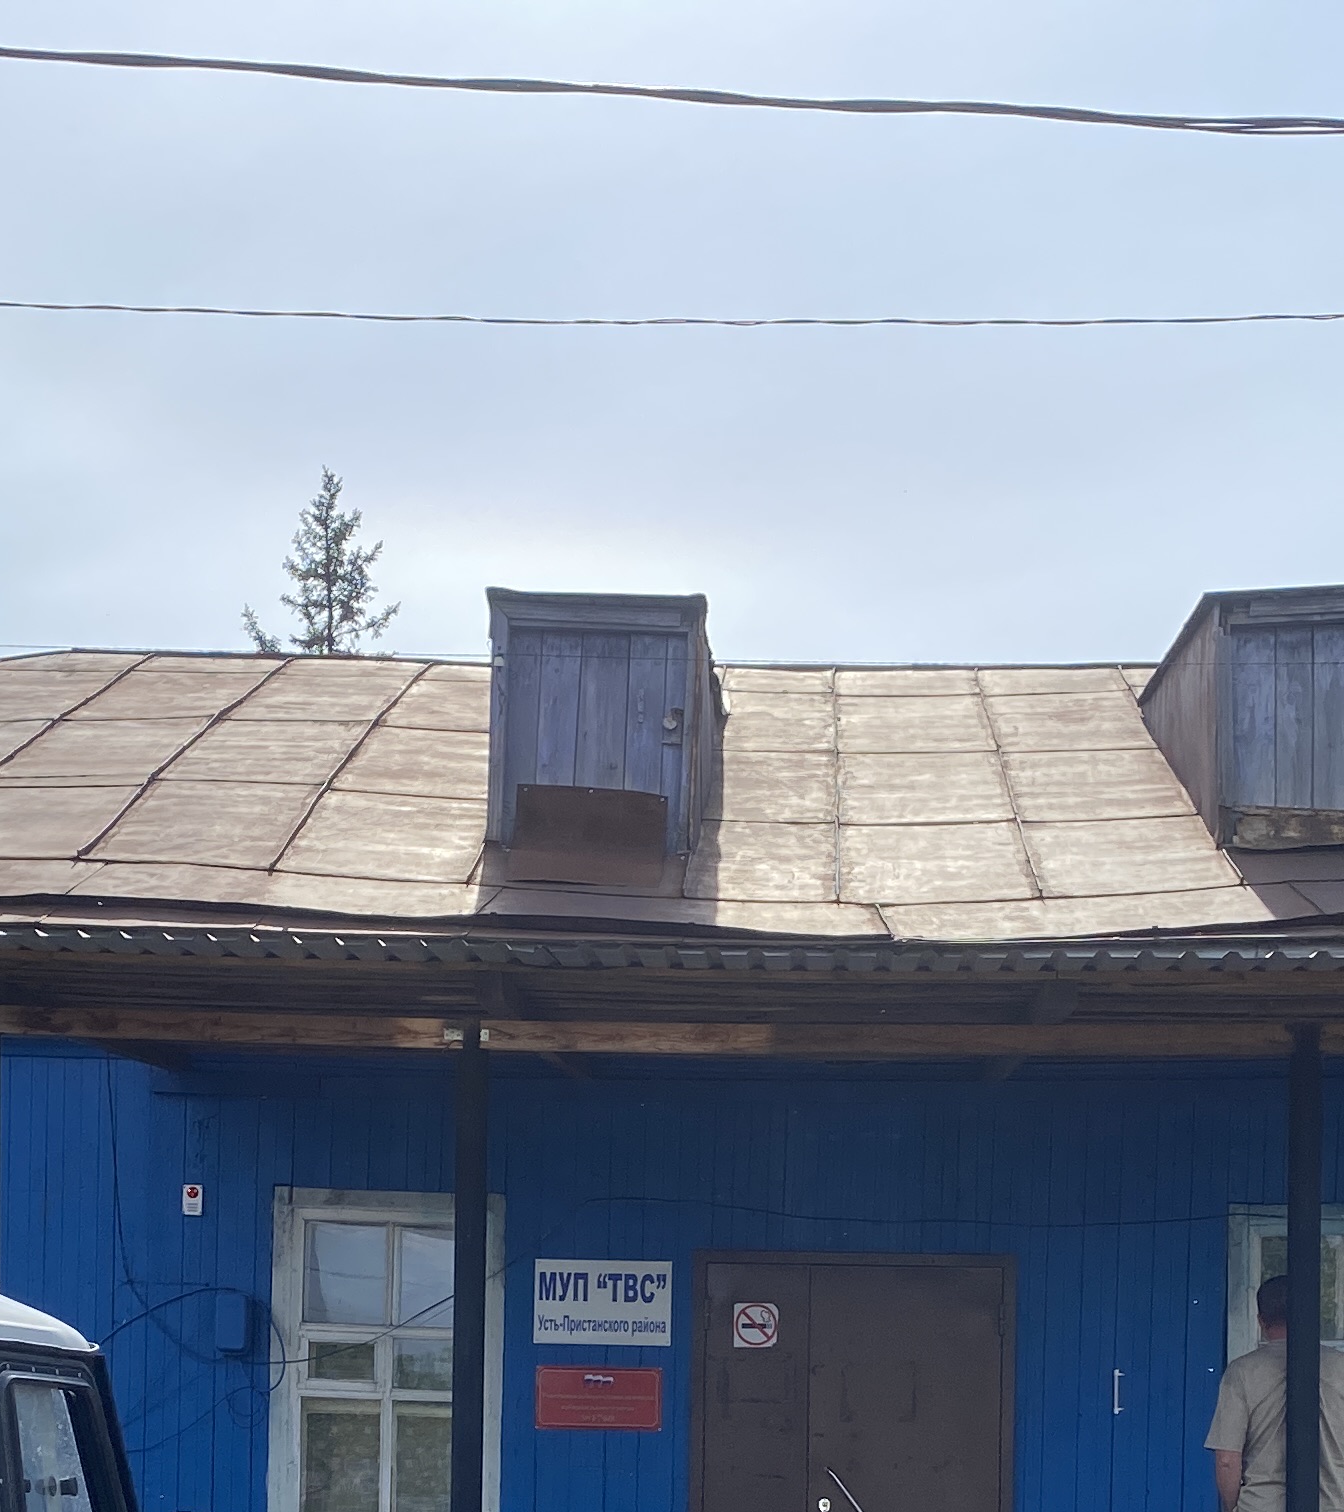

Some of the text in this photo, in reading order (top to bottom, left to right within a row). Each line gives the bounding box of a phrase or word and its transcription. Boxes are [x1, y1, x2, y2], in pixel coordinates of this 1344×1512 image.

[538, 1271, 589, 1302] МУП
[537, 1314, 667, 1337] Усть-Пристанского района
